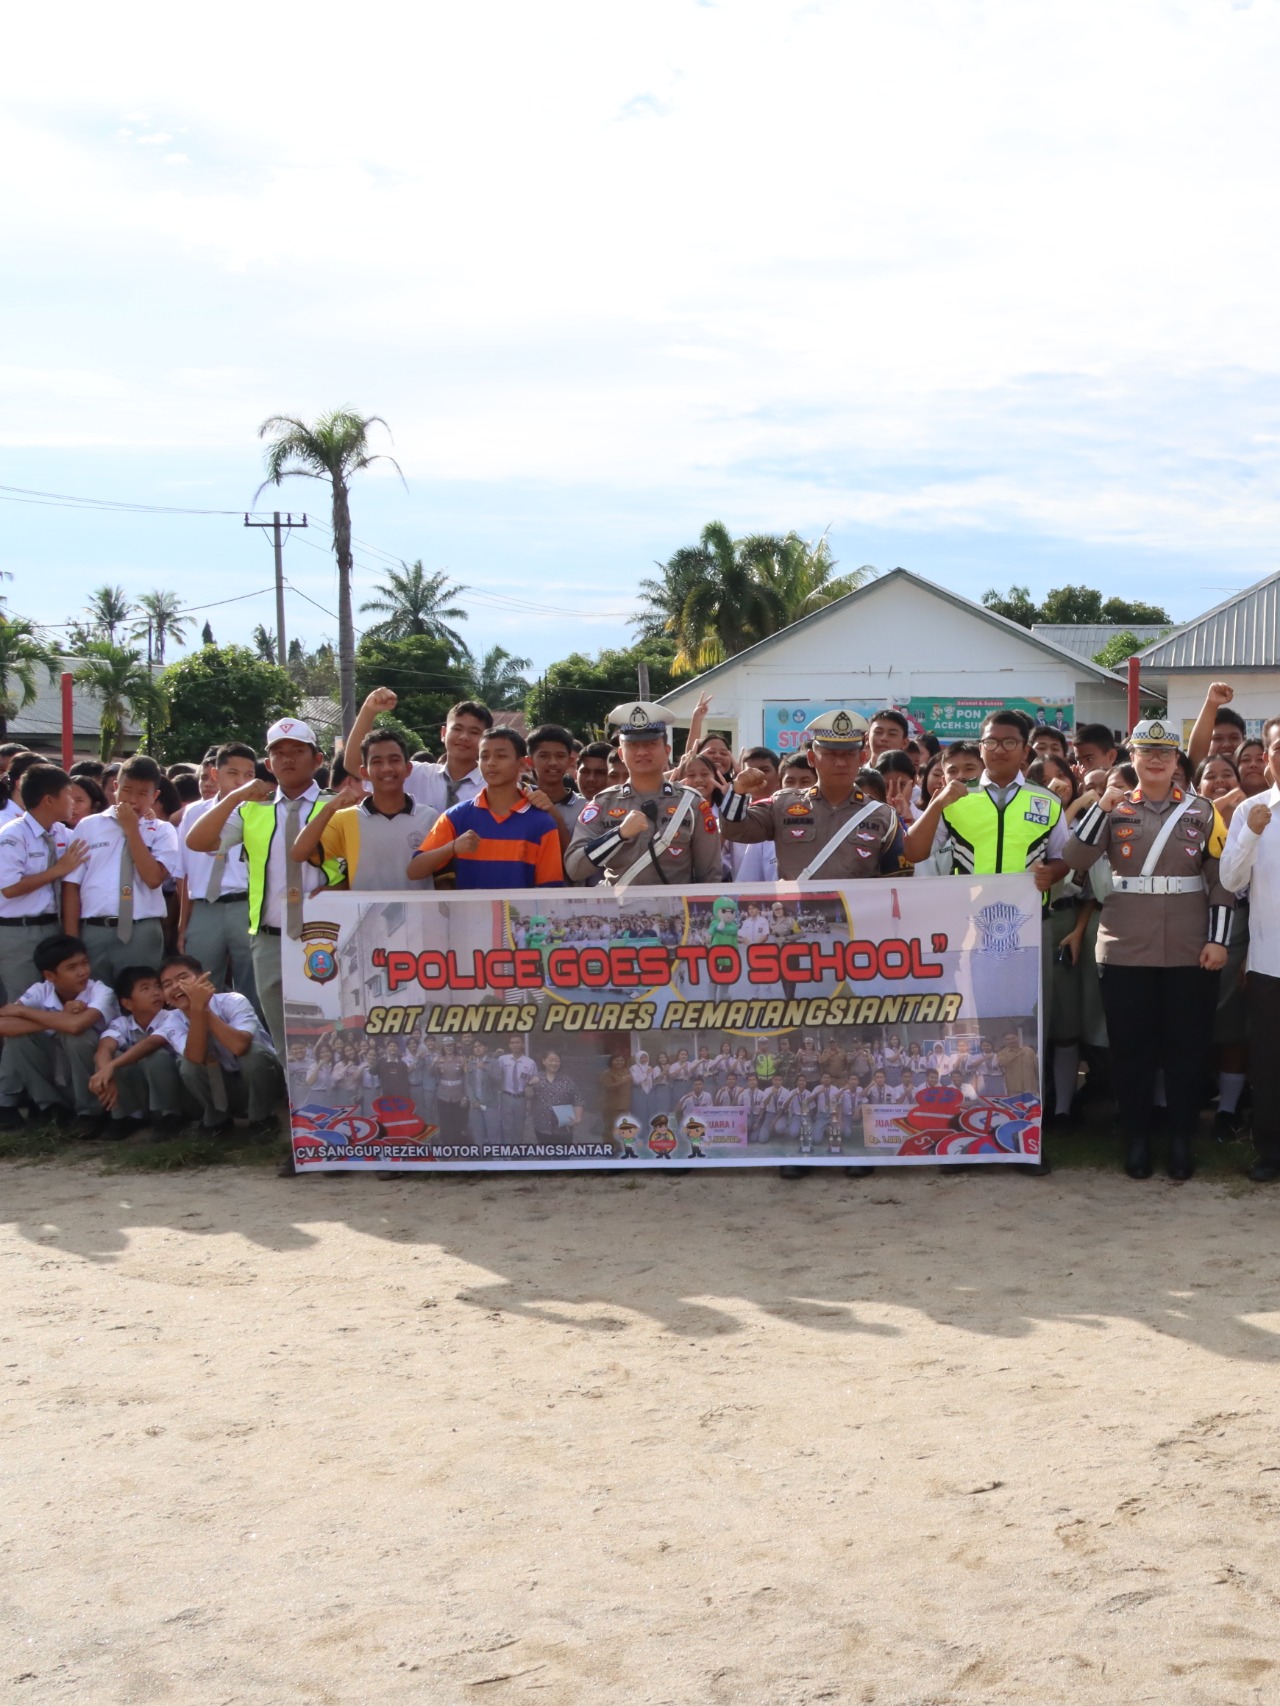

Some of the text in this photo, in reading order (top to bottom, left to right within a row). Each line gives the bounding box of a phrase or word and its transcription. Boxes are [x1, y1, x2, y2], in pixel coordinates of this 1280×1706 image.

[956, 710, 981, 719] PON
[778, 731, 813, 748] STO
[1026, 813, 1048, 825] PKS
[548, 946, 672, 989] GOES
[676, 944, 742, 985] TO
[365, 993, 963, 1036] SAT LANTAS POLRES PEMATANGSIANTAR
[296, 1144, 613, 1159] CV.SANGGUP REZEKI MOTOR PEMATANGSIANTAR
